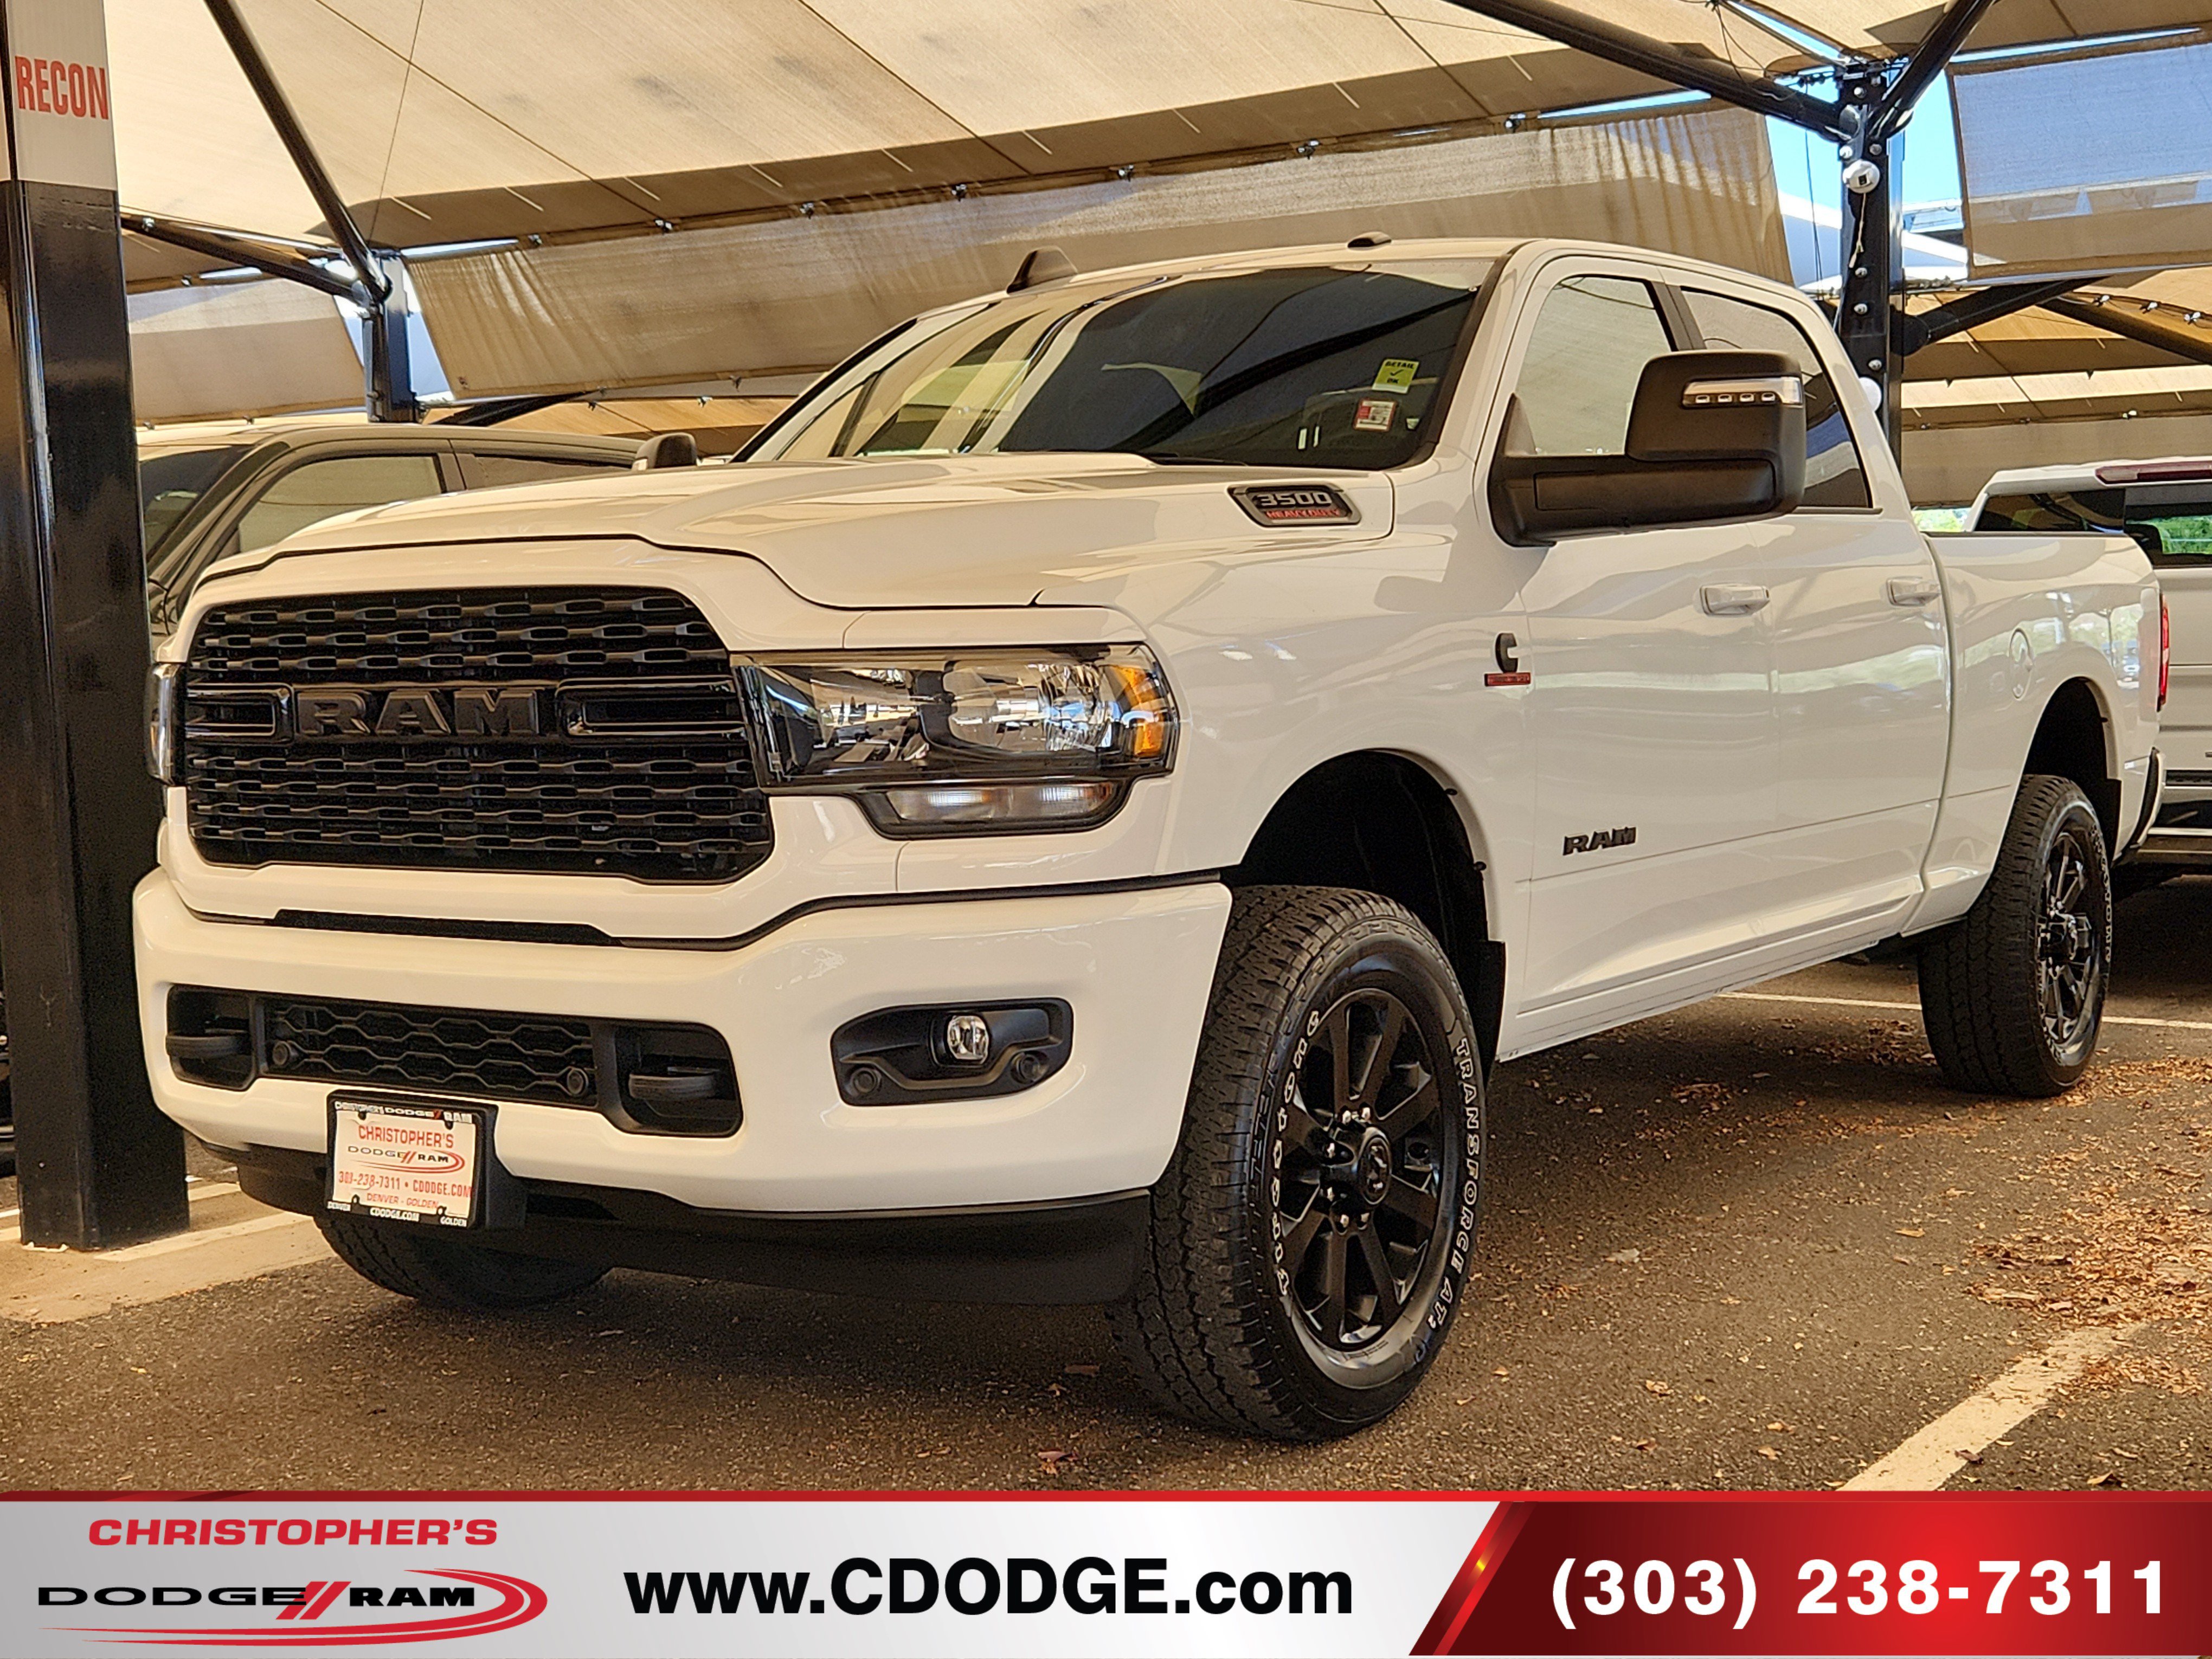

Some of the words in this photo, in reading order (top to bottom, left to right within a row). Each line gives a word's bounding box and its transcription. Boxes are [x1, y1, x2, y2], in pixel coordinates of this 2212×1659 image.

[15, 55, 109, 120] RECON
[1384, 361, 1414, 369] DETAIL
[1257, 492, 1333, 506] 3500
[1265, 510, 1307, 518] HEAVY
[1308, 509, 1340, 517] DUTY
[297, 689, 540, 734] RAM
[1563, 826, 1636, 856] RAM
[358, 1124, 454, 1149] CHRISTOPHER'S
[348, 1146, 407, 1158] DODGE
[417, 1154, 449, 1163] RAM
[413, 1181, 472, 1198] CDODGE.COM
[366, 1192, 399, 1205] DENVER
[406, 1197, 439, 1209] GOLDEN
